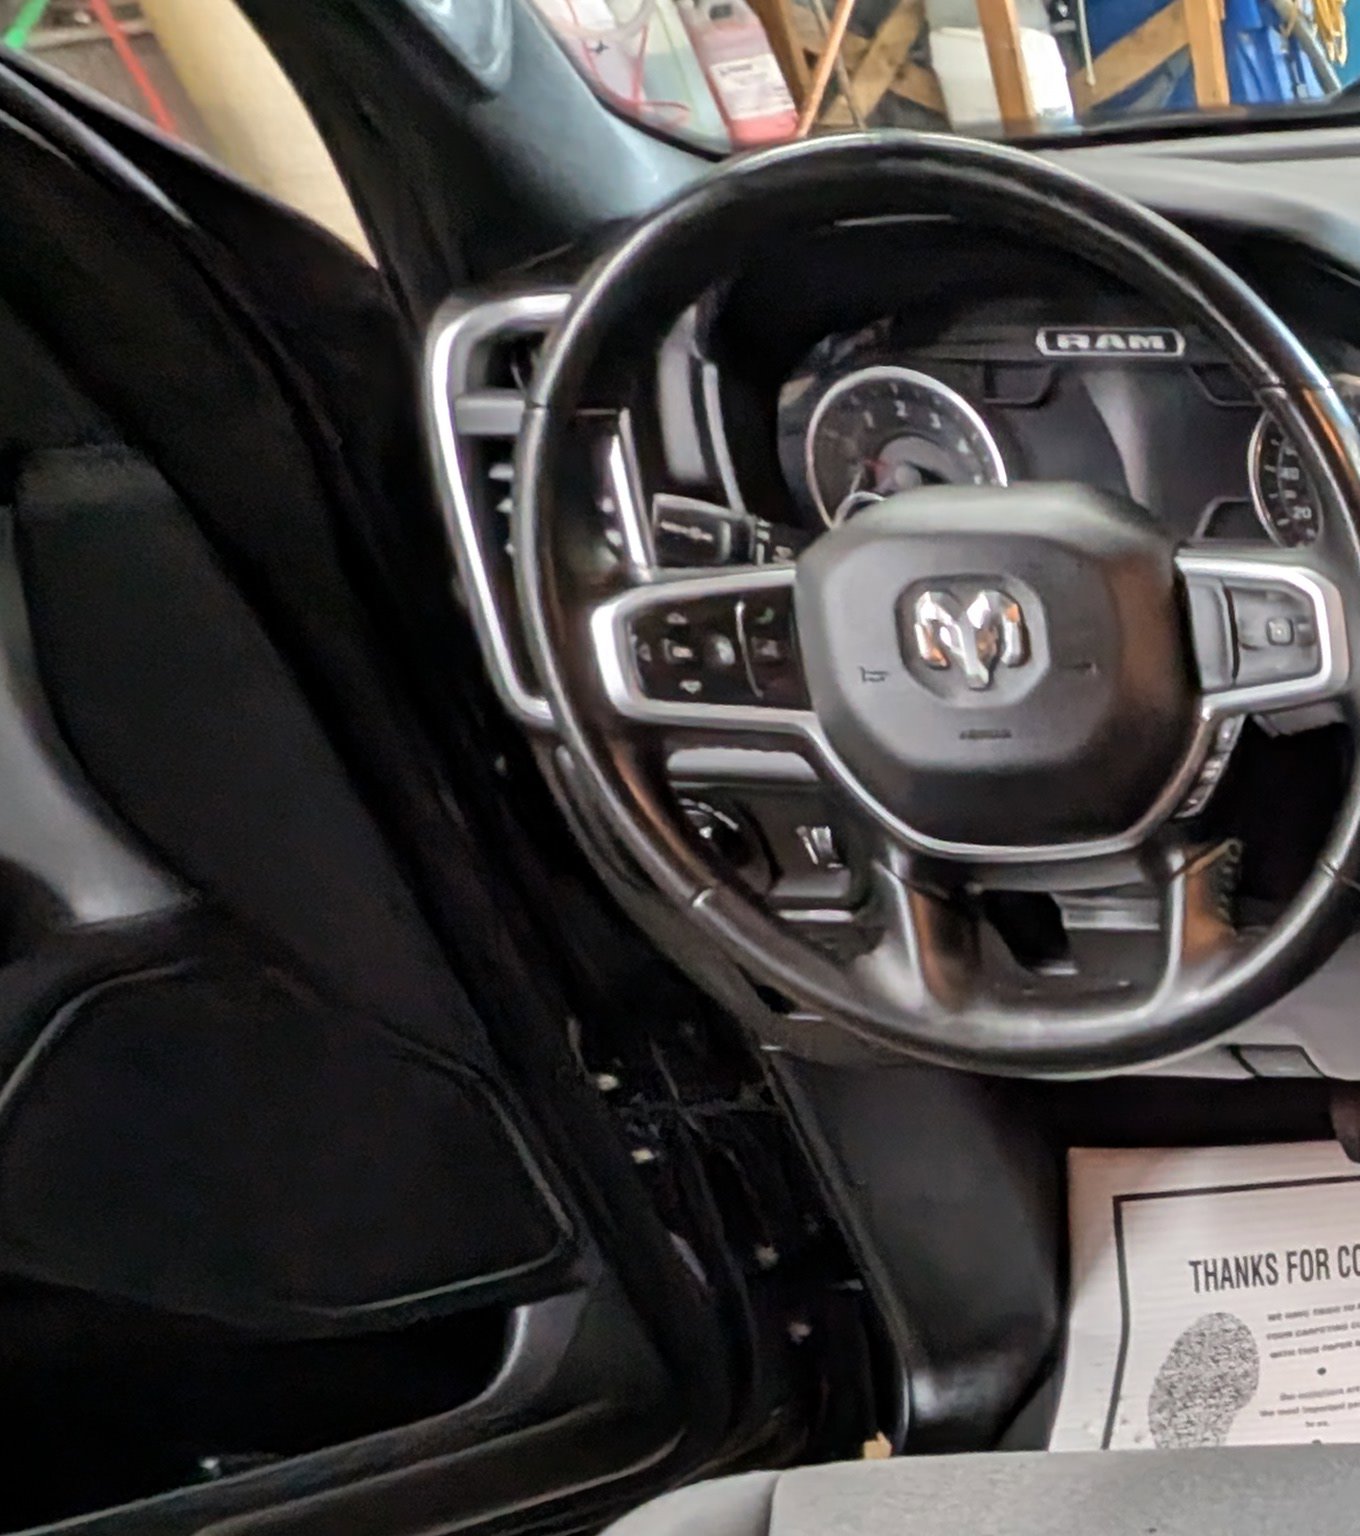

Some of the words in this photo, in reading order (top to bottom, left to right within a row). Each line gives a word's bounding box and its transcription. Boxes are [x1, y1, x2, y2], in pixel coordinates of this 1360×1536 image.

[1056, 333, 1166, 350] RAM
[1292, 505, 1313, 520] 20
[1188, 1252, 1280, 1294] THANKS
[1286, 1248, 1331, 1284] FOR
